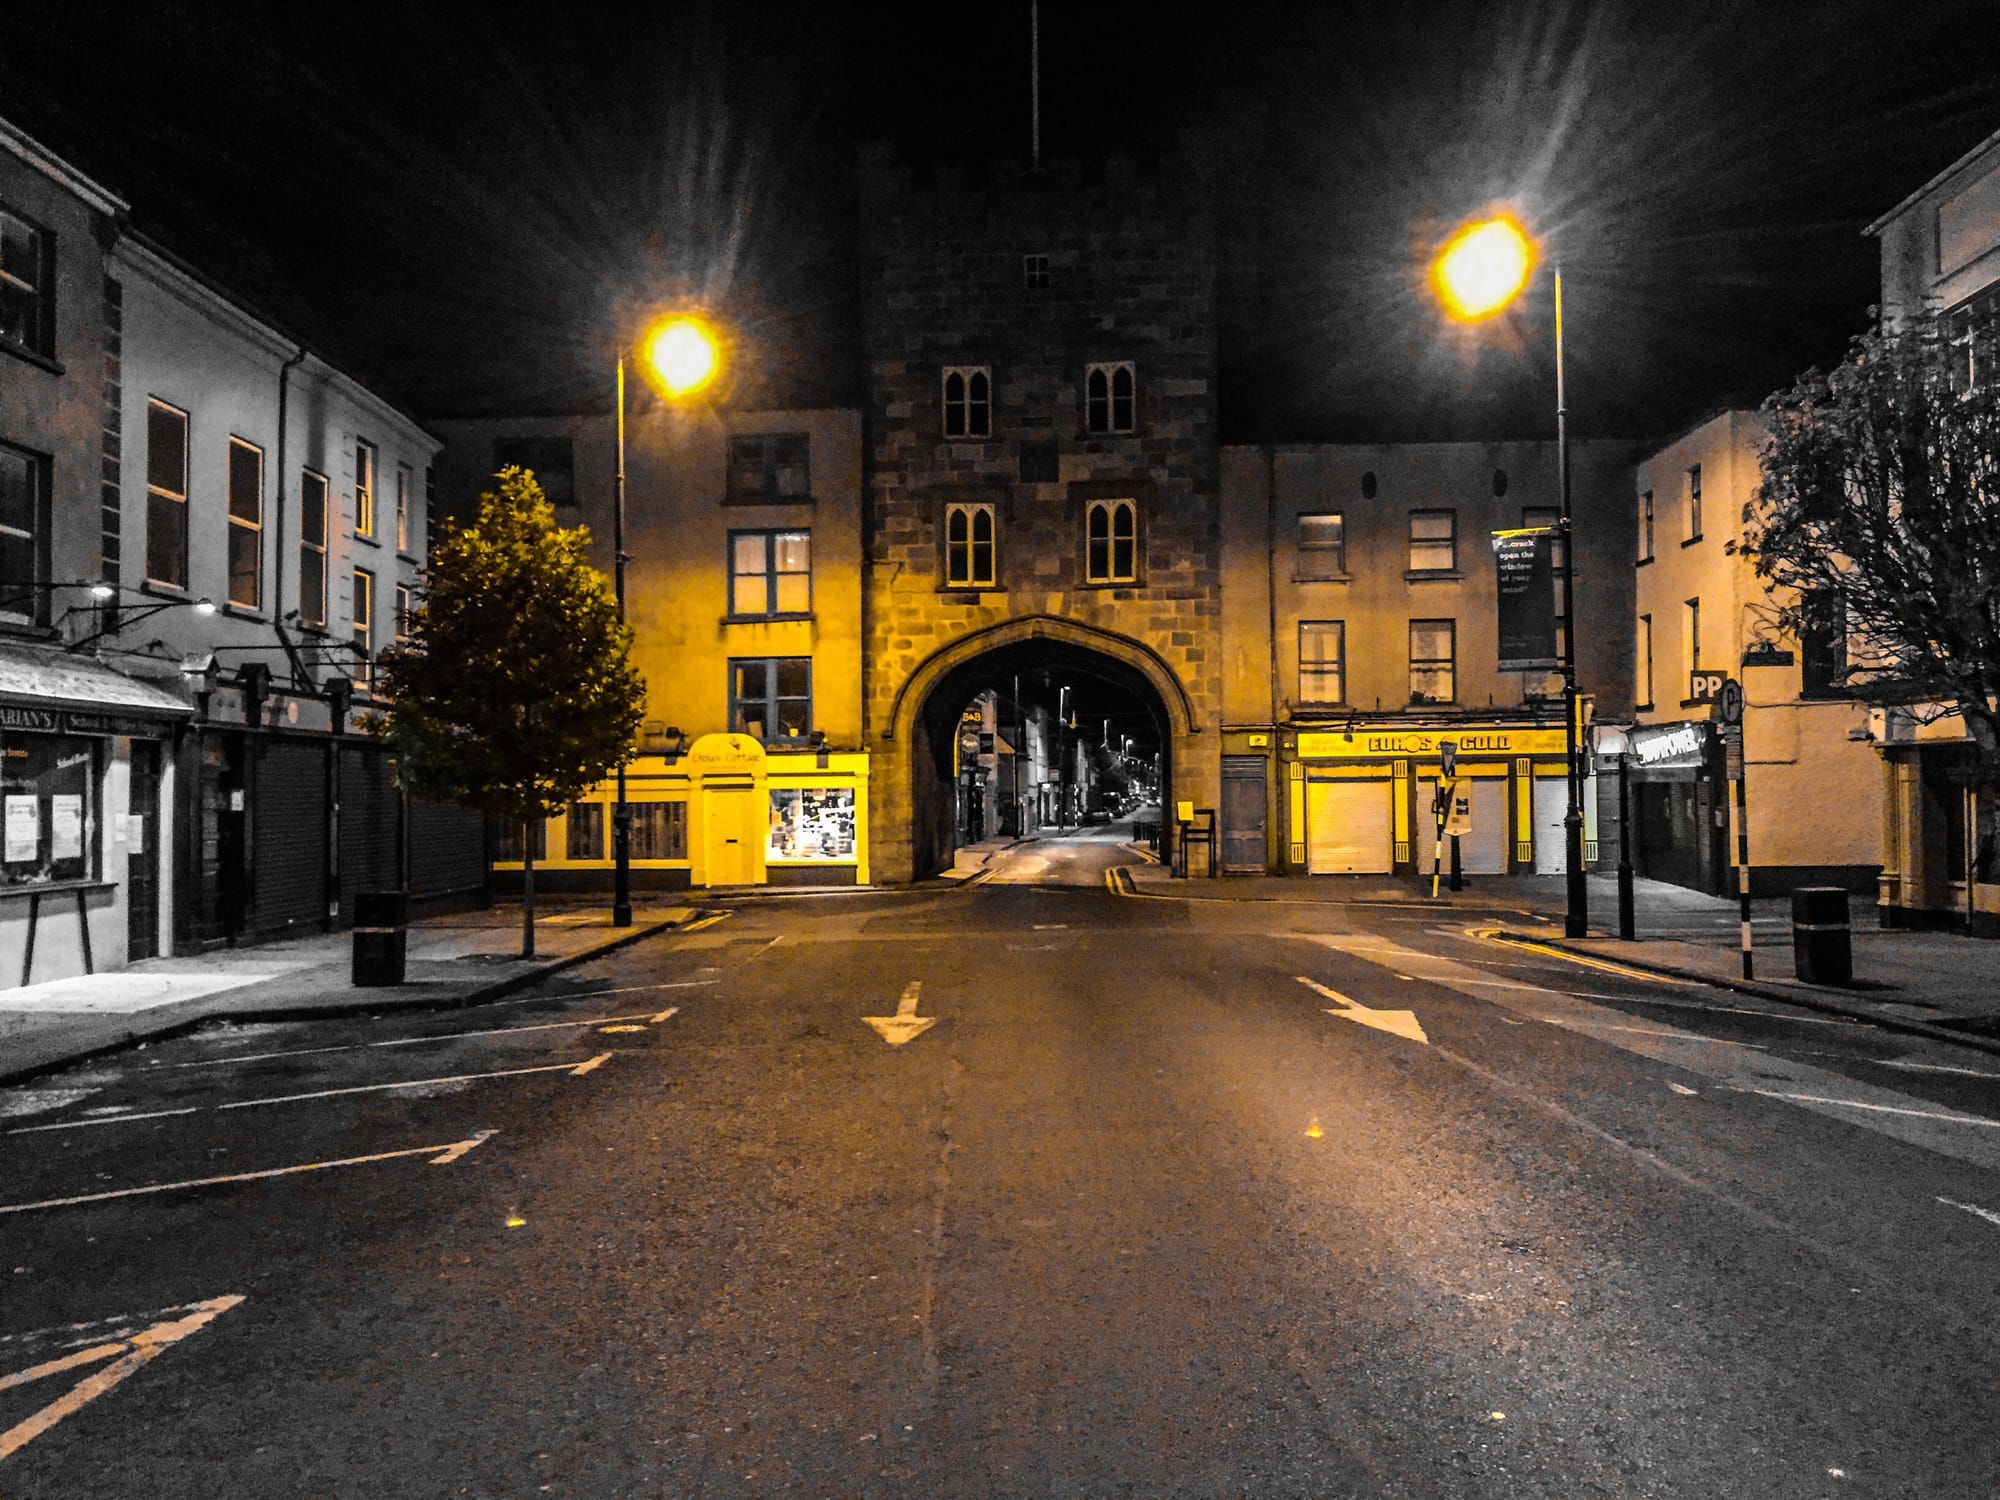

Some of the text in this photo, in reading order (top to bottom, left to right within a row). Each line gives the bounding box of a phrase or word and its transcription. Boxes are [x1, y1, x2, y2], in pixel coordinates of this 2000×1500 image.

[1692, 676, 1723, 699] PP
[1369, 735, 1432, 753] EUROS
[1460, 735, 1512, 751] GOLD
